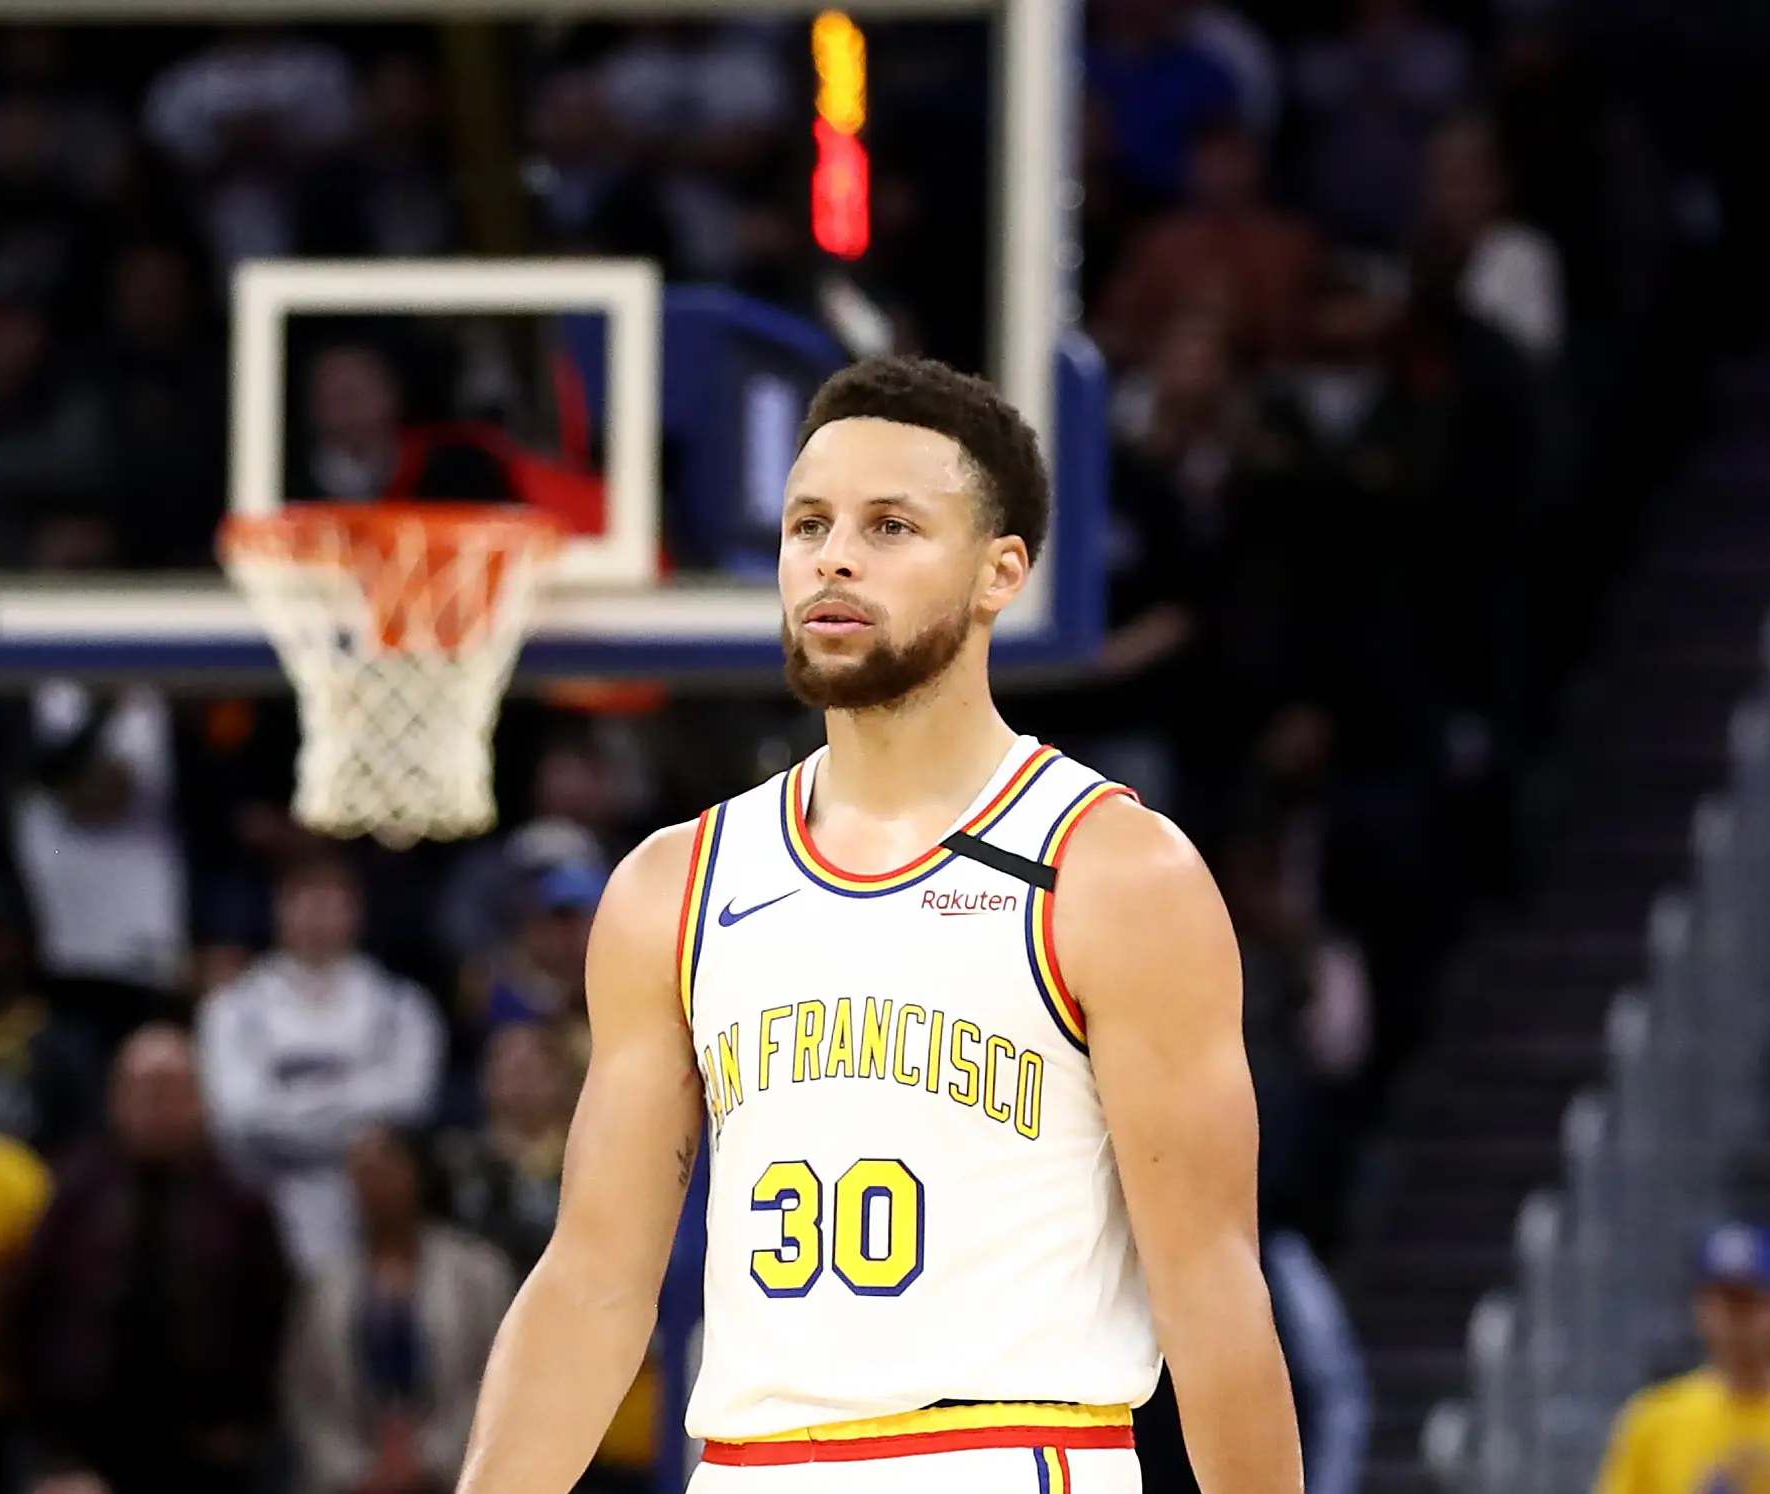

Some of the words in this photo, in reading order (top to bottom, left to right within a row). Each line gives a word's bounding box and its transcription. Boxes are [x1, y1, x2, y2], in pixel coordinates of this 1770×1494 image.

[920, 888, 1018, 912] Rakuten
[702, 1021, 745, 1137] AN
[757, 995, 1044, 1141] FRANCISCO
[749, 1157, 926, 1299] 30
